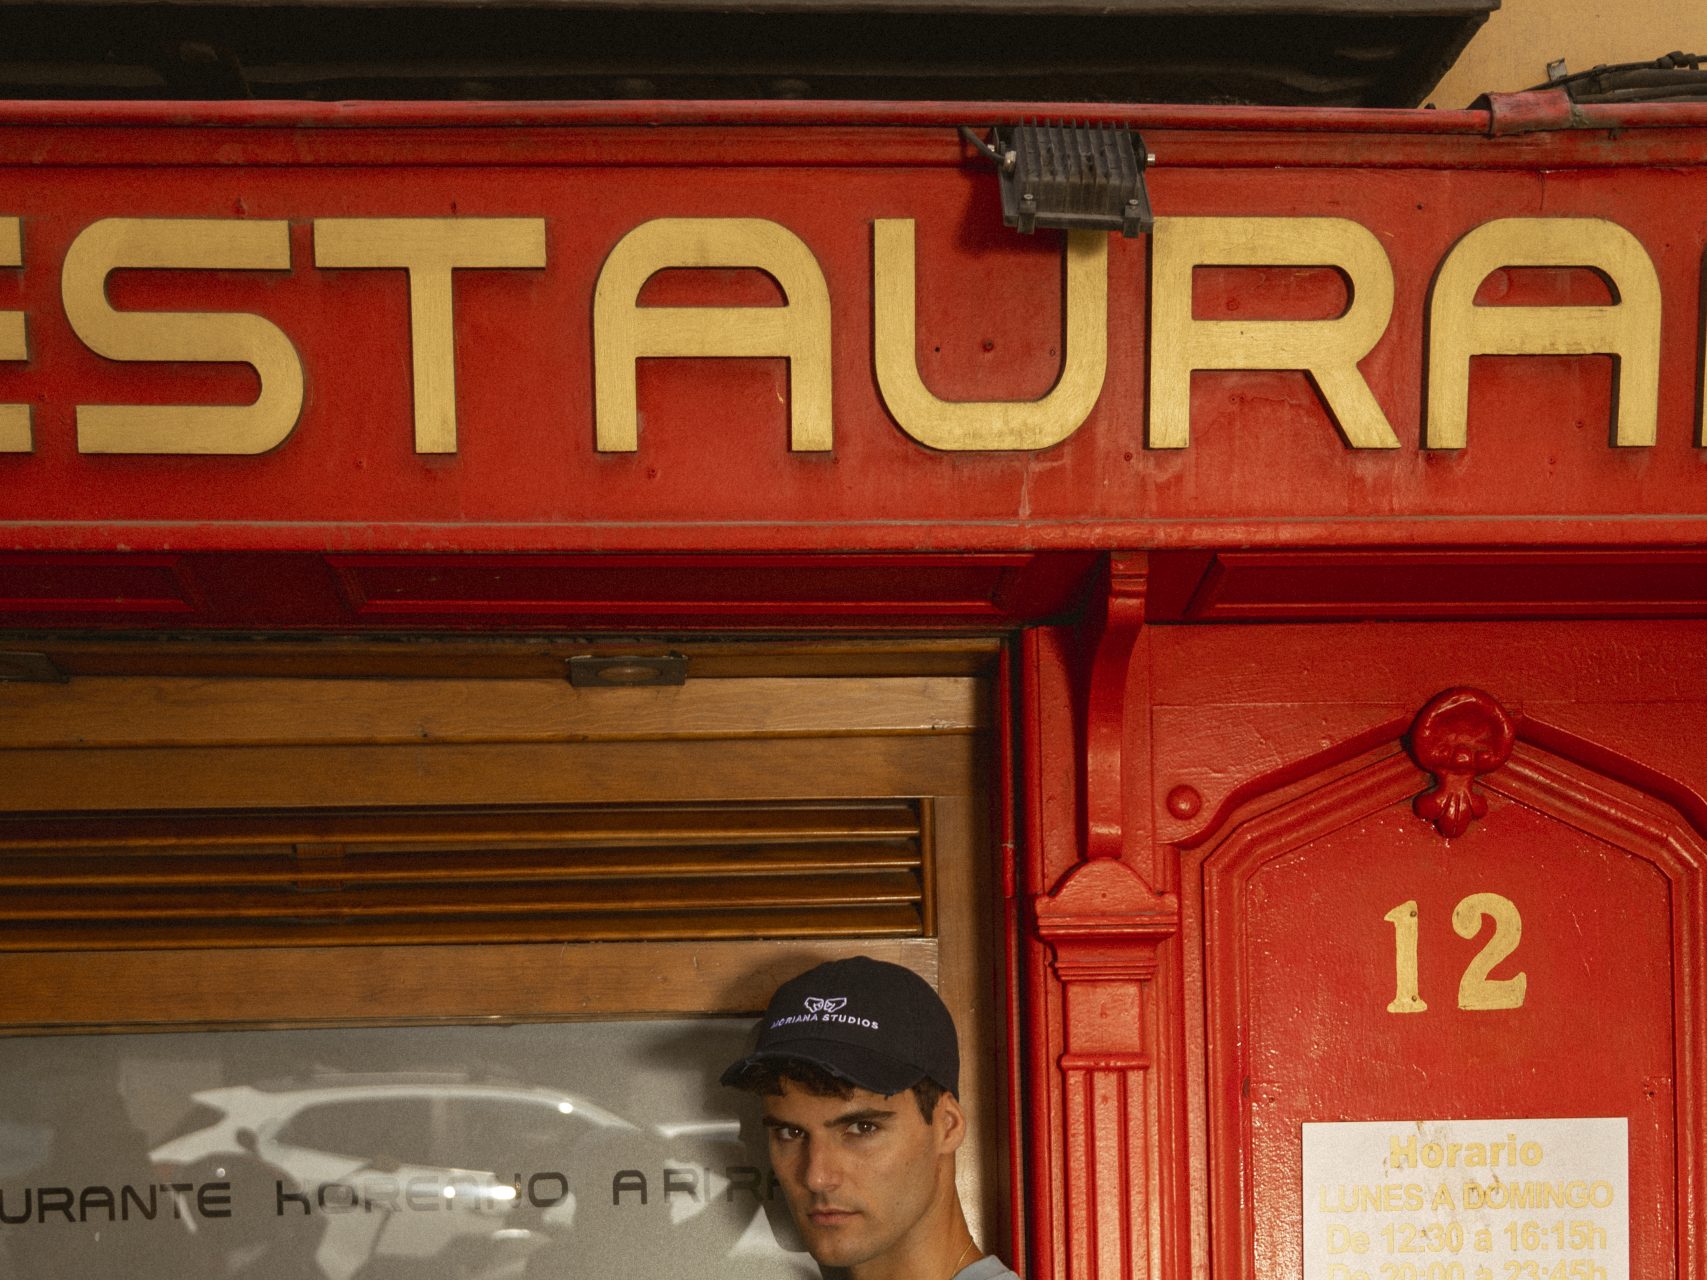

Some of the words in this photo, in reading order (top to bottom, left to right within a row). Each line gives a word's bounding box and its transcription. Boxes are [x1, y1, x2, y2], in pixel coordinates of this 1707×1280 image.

[0, 216, 1707, 455] STAURA
[1383, 892, 1527, 1014] 12
[822, 1013, 880, 1031] STUDIOS
[1388, 1133, 1544, 1169] Horario
[1319, 1182, 1424, 1213] LUNES
[1431, 1182, 1455, 1211] A
[1462, 1179, 1615, 1210] DOMINGO
[1326, 1223, 1370, 1254] De
[1380, 1221, 1464, 1254] 12:30
[1474, 1228, 1493, 1251] a
[1503, 1219, 1608, 1251] 16:15h
